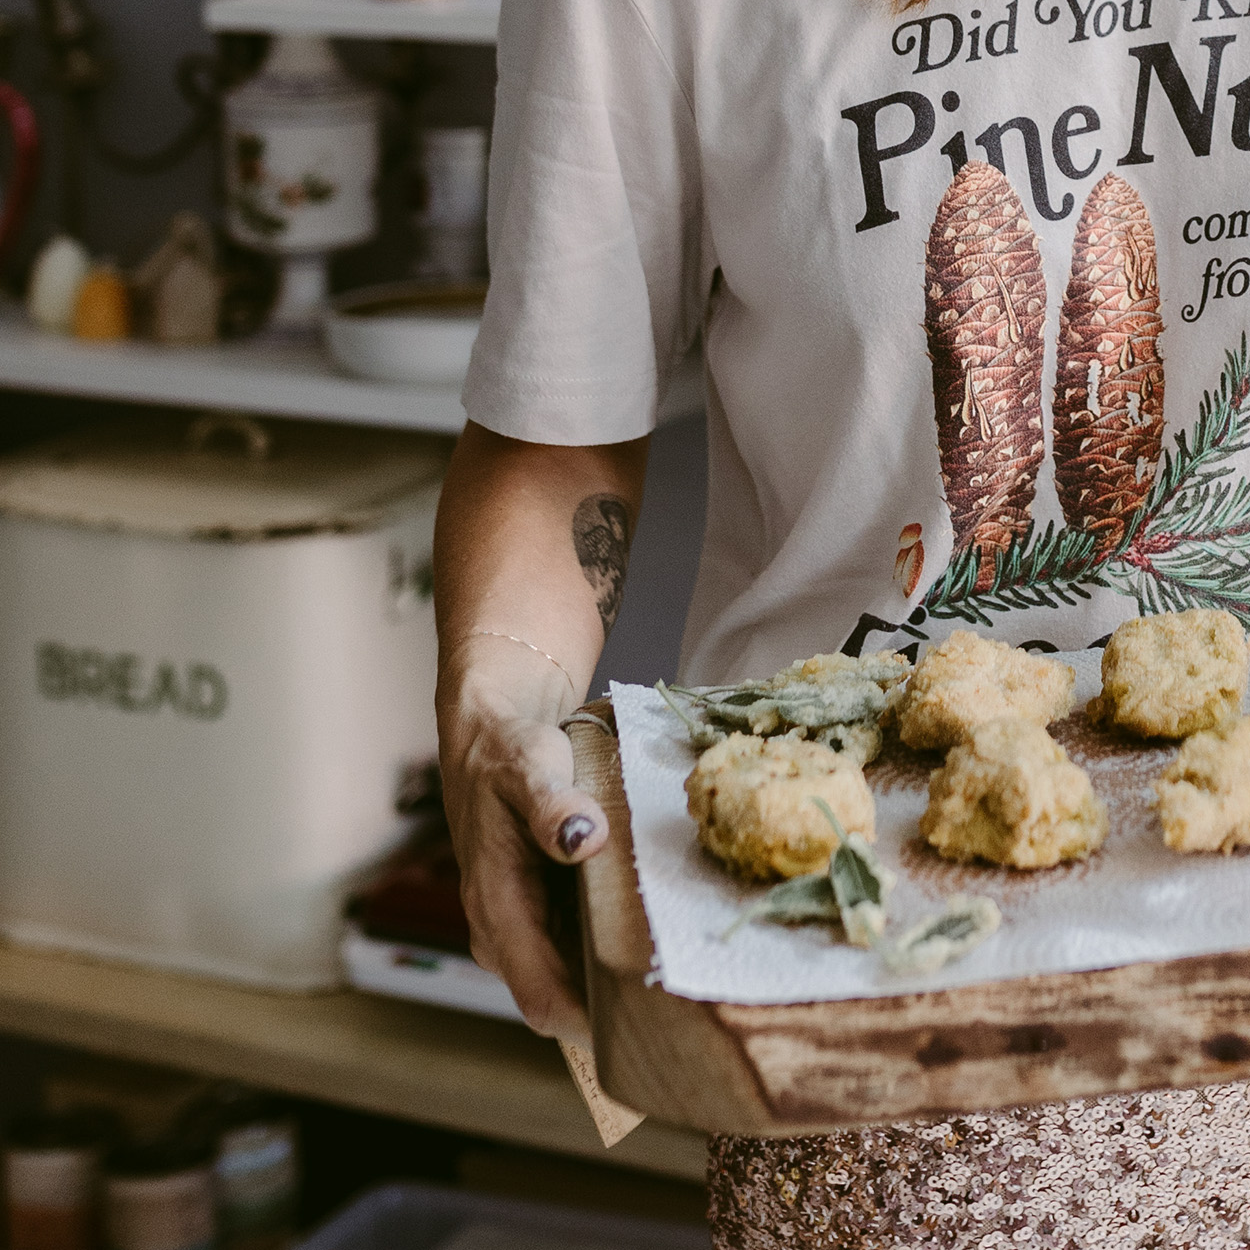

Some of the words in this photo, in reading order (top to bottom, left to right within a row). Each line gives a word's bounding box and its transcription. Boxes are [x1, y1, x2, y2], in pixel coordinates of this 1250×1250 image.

[892, 0, 1018, 75] Did
[841, 90, 1102, 233] Pine
[36, 640, 229, 721] BREAD
